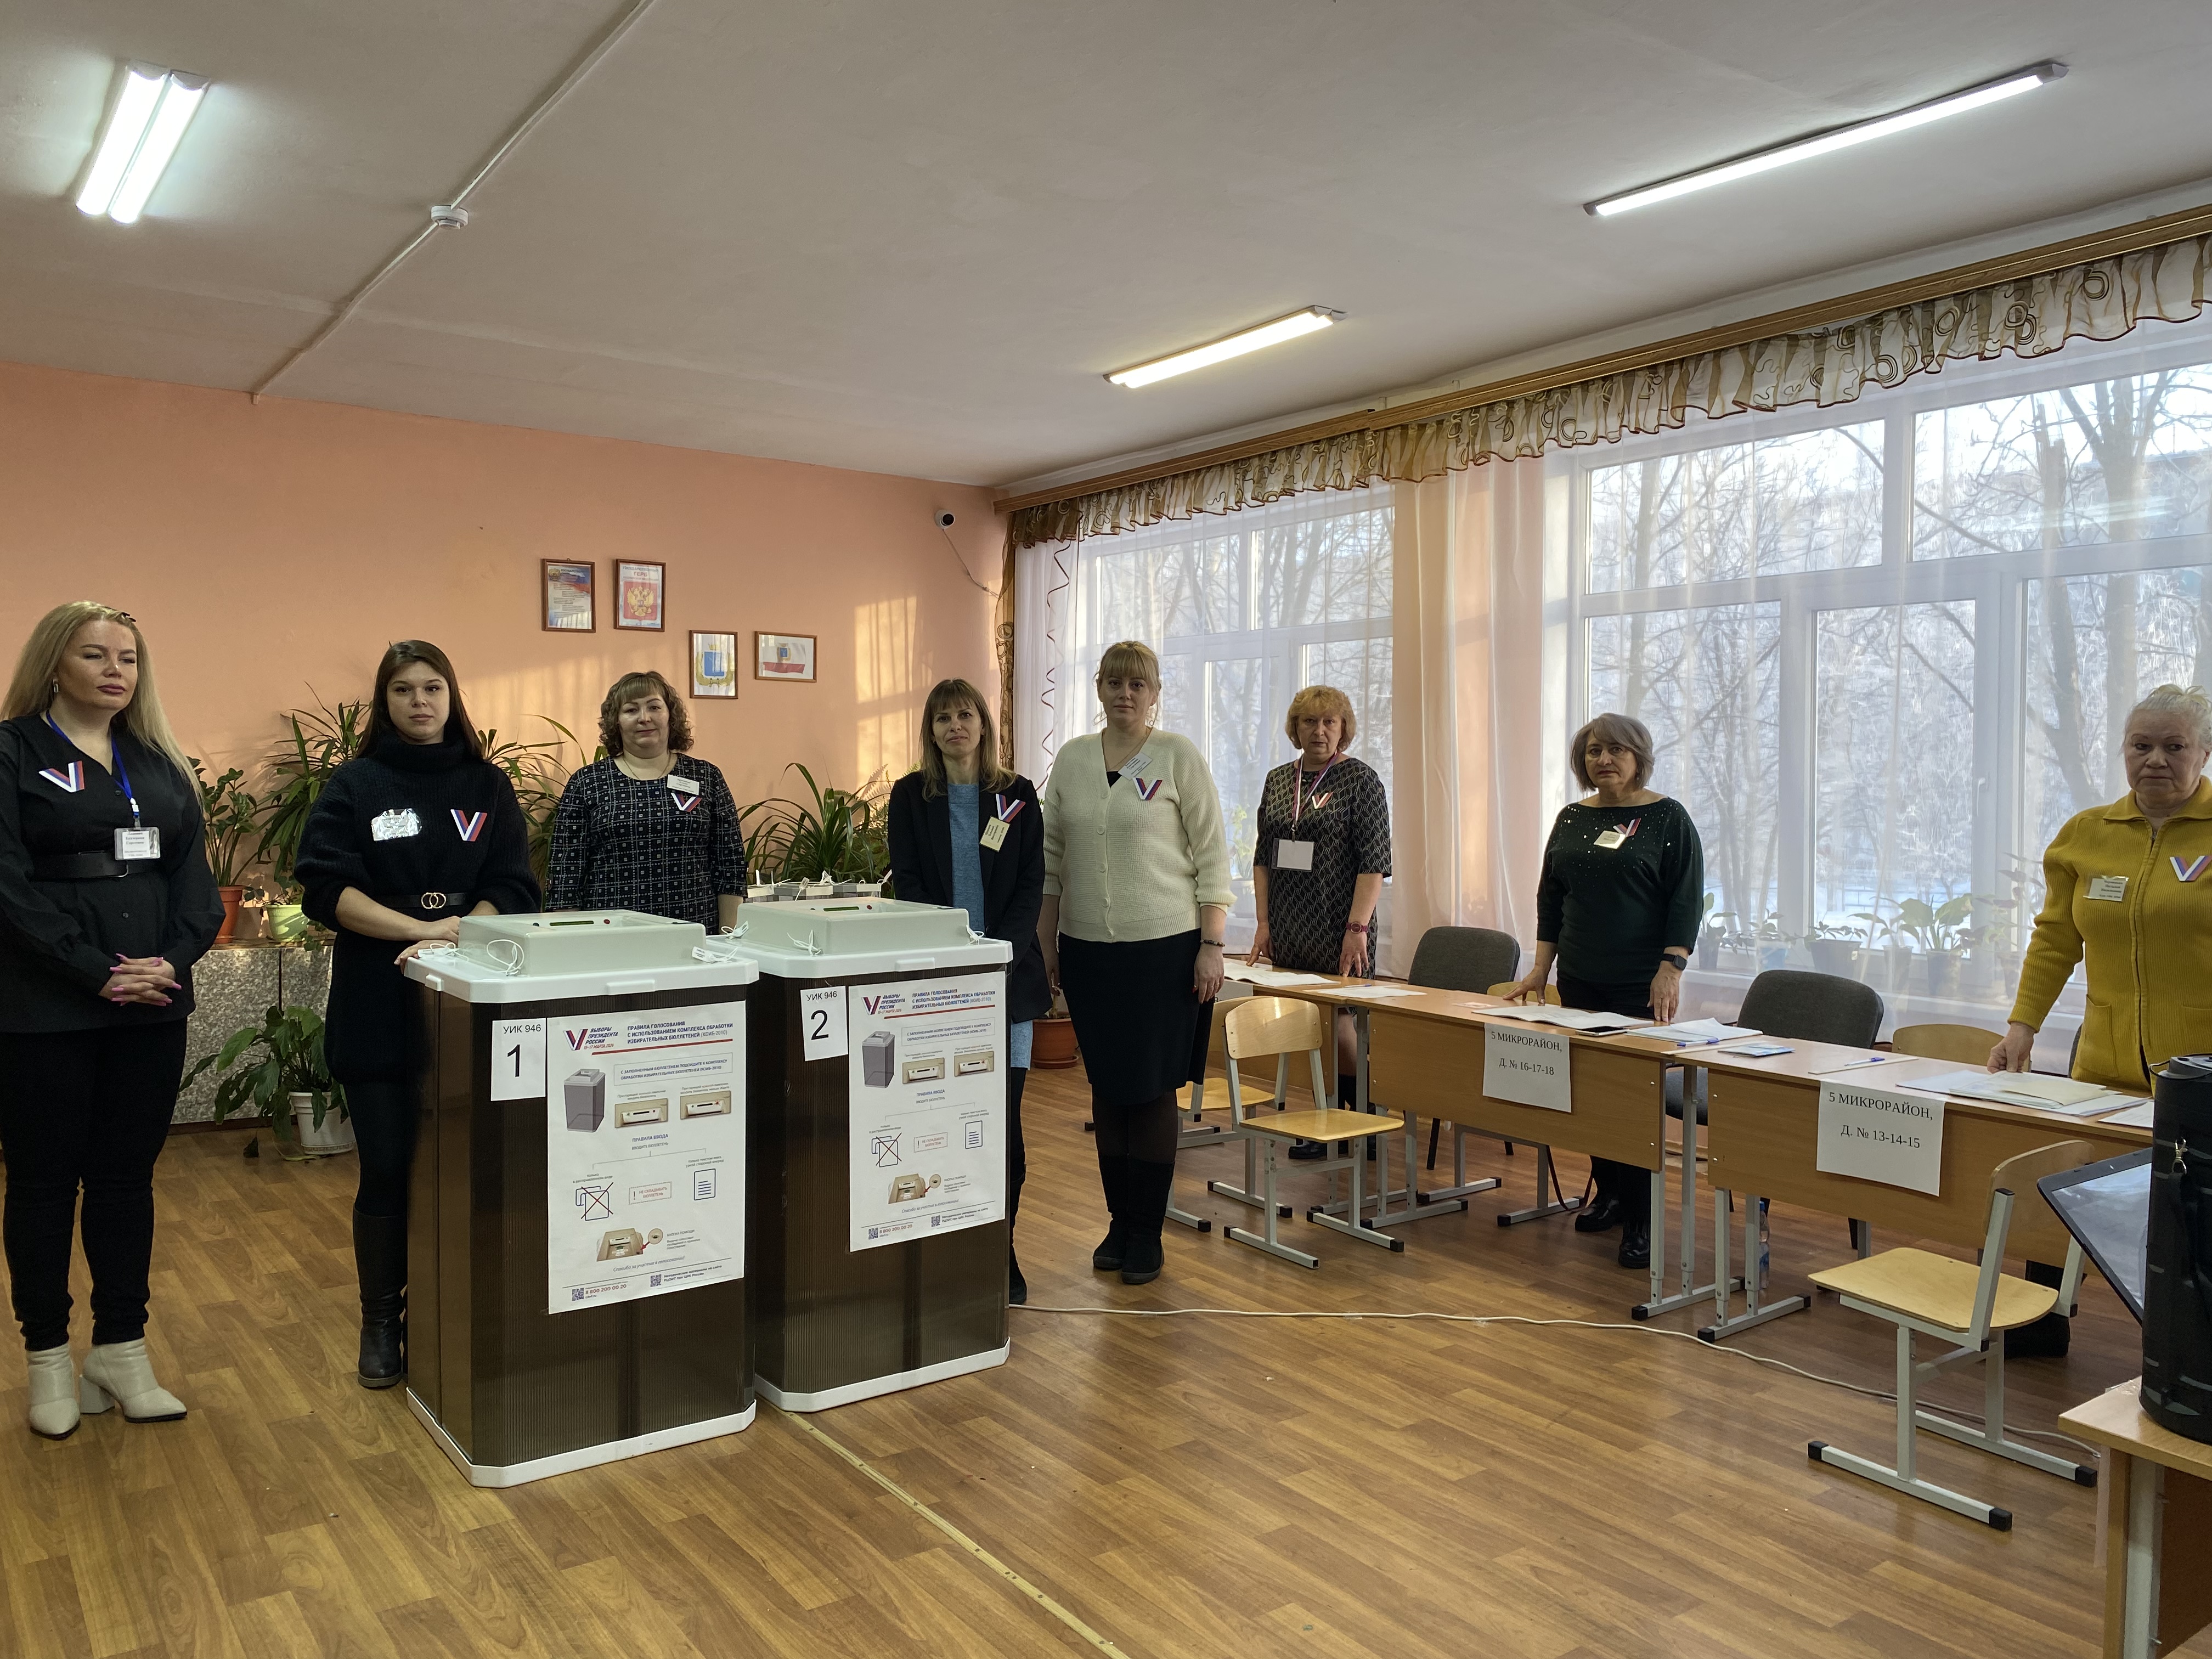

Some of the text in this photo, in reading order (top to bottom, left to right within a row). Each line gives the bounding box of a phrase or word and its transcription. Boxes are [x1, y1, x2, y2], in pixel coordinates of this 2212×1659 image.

[806, 991, 837, 1001] УИК 946
[503, 1024, 541, 1034] УИК 946
[811, 1009, 828, 1040] 2
[627, 1035, 668, 1043] ИЗБИРАТЕЛЬНЫХ
[701, 1030, 727, 1038] (КОИБ-2010)
[1491, 1031, 1562, 1053] 5 МИКРОРАЙОН,
[507, 1044, 520, 1077] 1
[1499, 1058, 1554, 1075] Д. № 16-17-18
[1829, 1092, 1933, 1121] 5 МИКРОРАЙОН,
[1841, 1125, 1920, 1148] Д. № 13-14-15
[637, 1261, 654, 1269] участие
